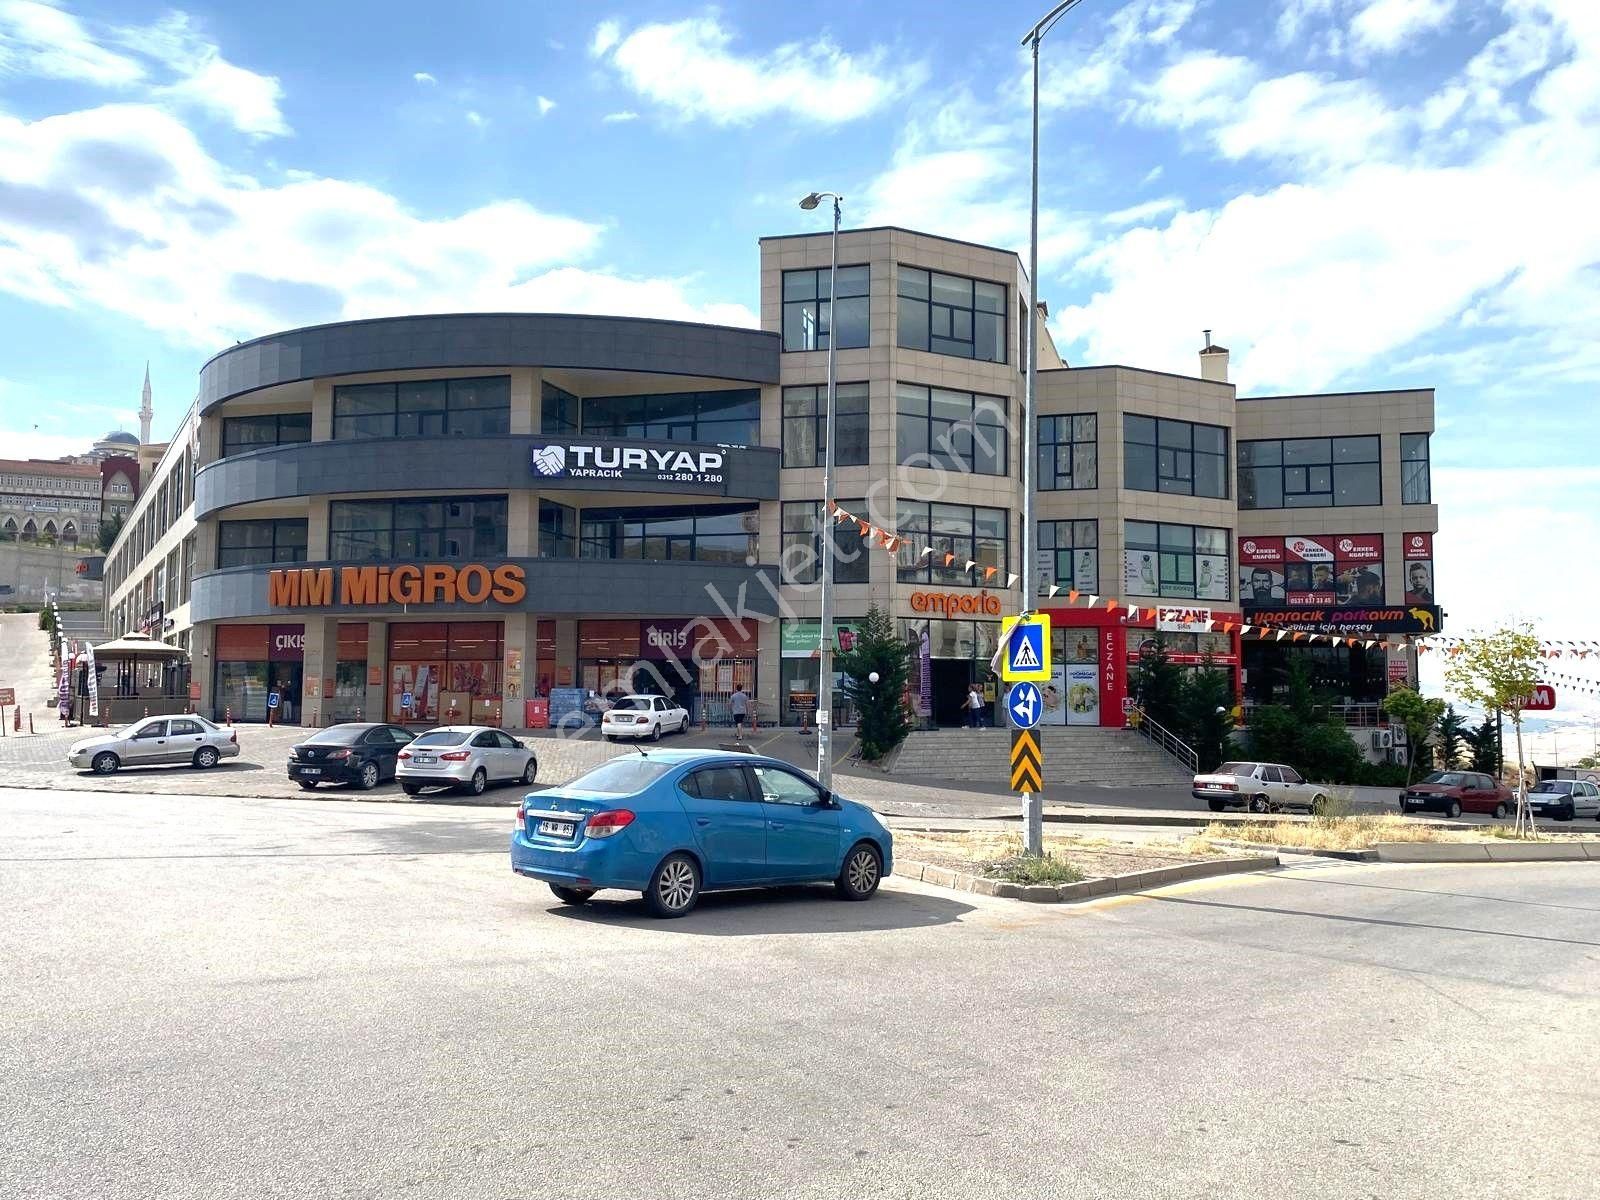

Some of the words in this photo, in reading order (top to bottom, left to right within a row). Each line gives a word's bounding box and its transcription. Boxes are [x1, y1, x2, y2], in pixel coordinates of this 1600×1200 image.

[570, 445, 723, 473] TURYAP
[570, 468, 623, 478] YAPRACIK
[675, 473, 693, 481] 280
[704, 474, 723, 482] 280
[269, 568, 334, 607] MM
[1106, 632, 1114, 691] ECZANE
